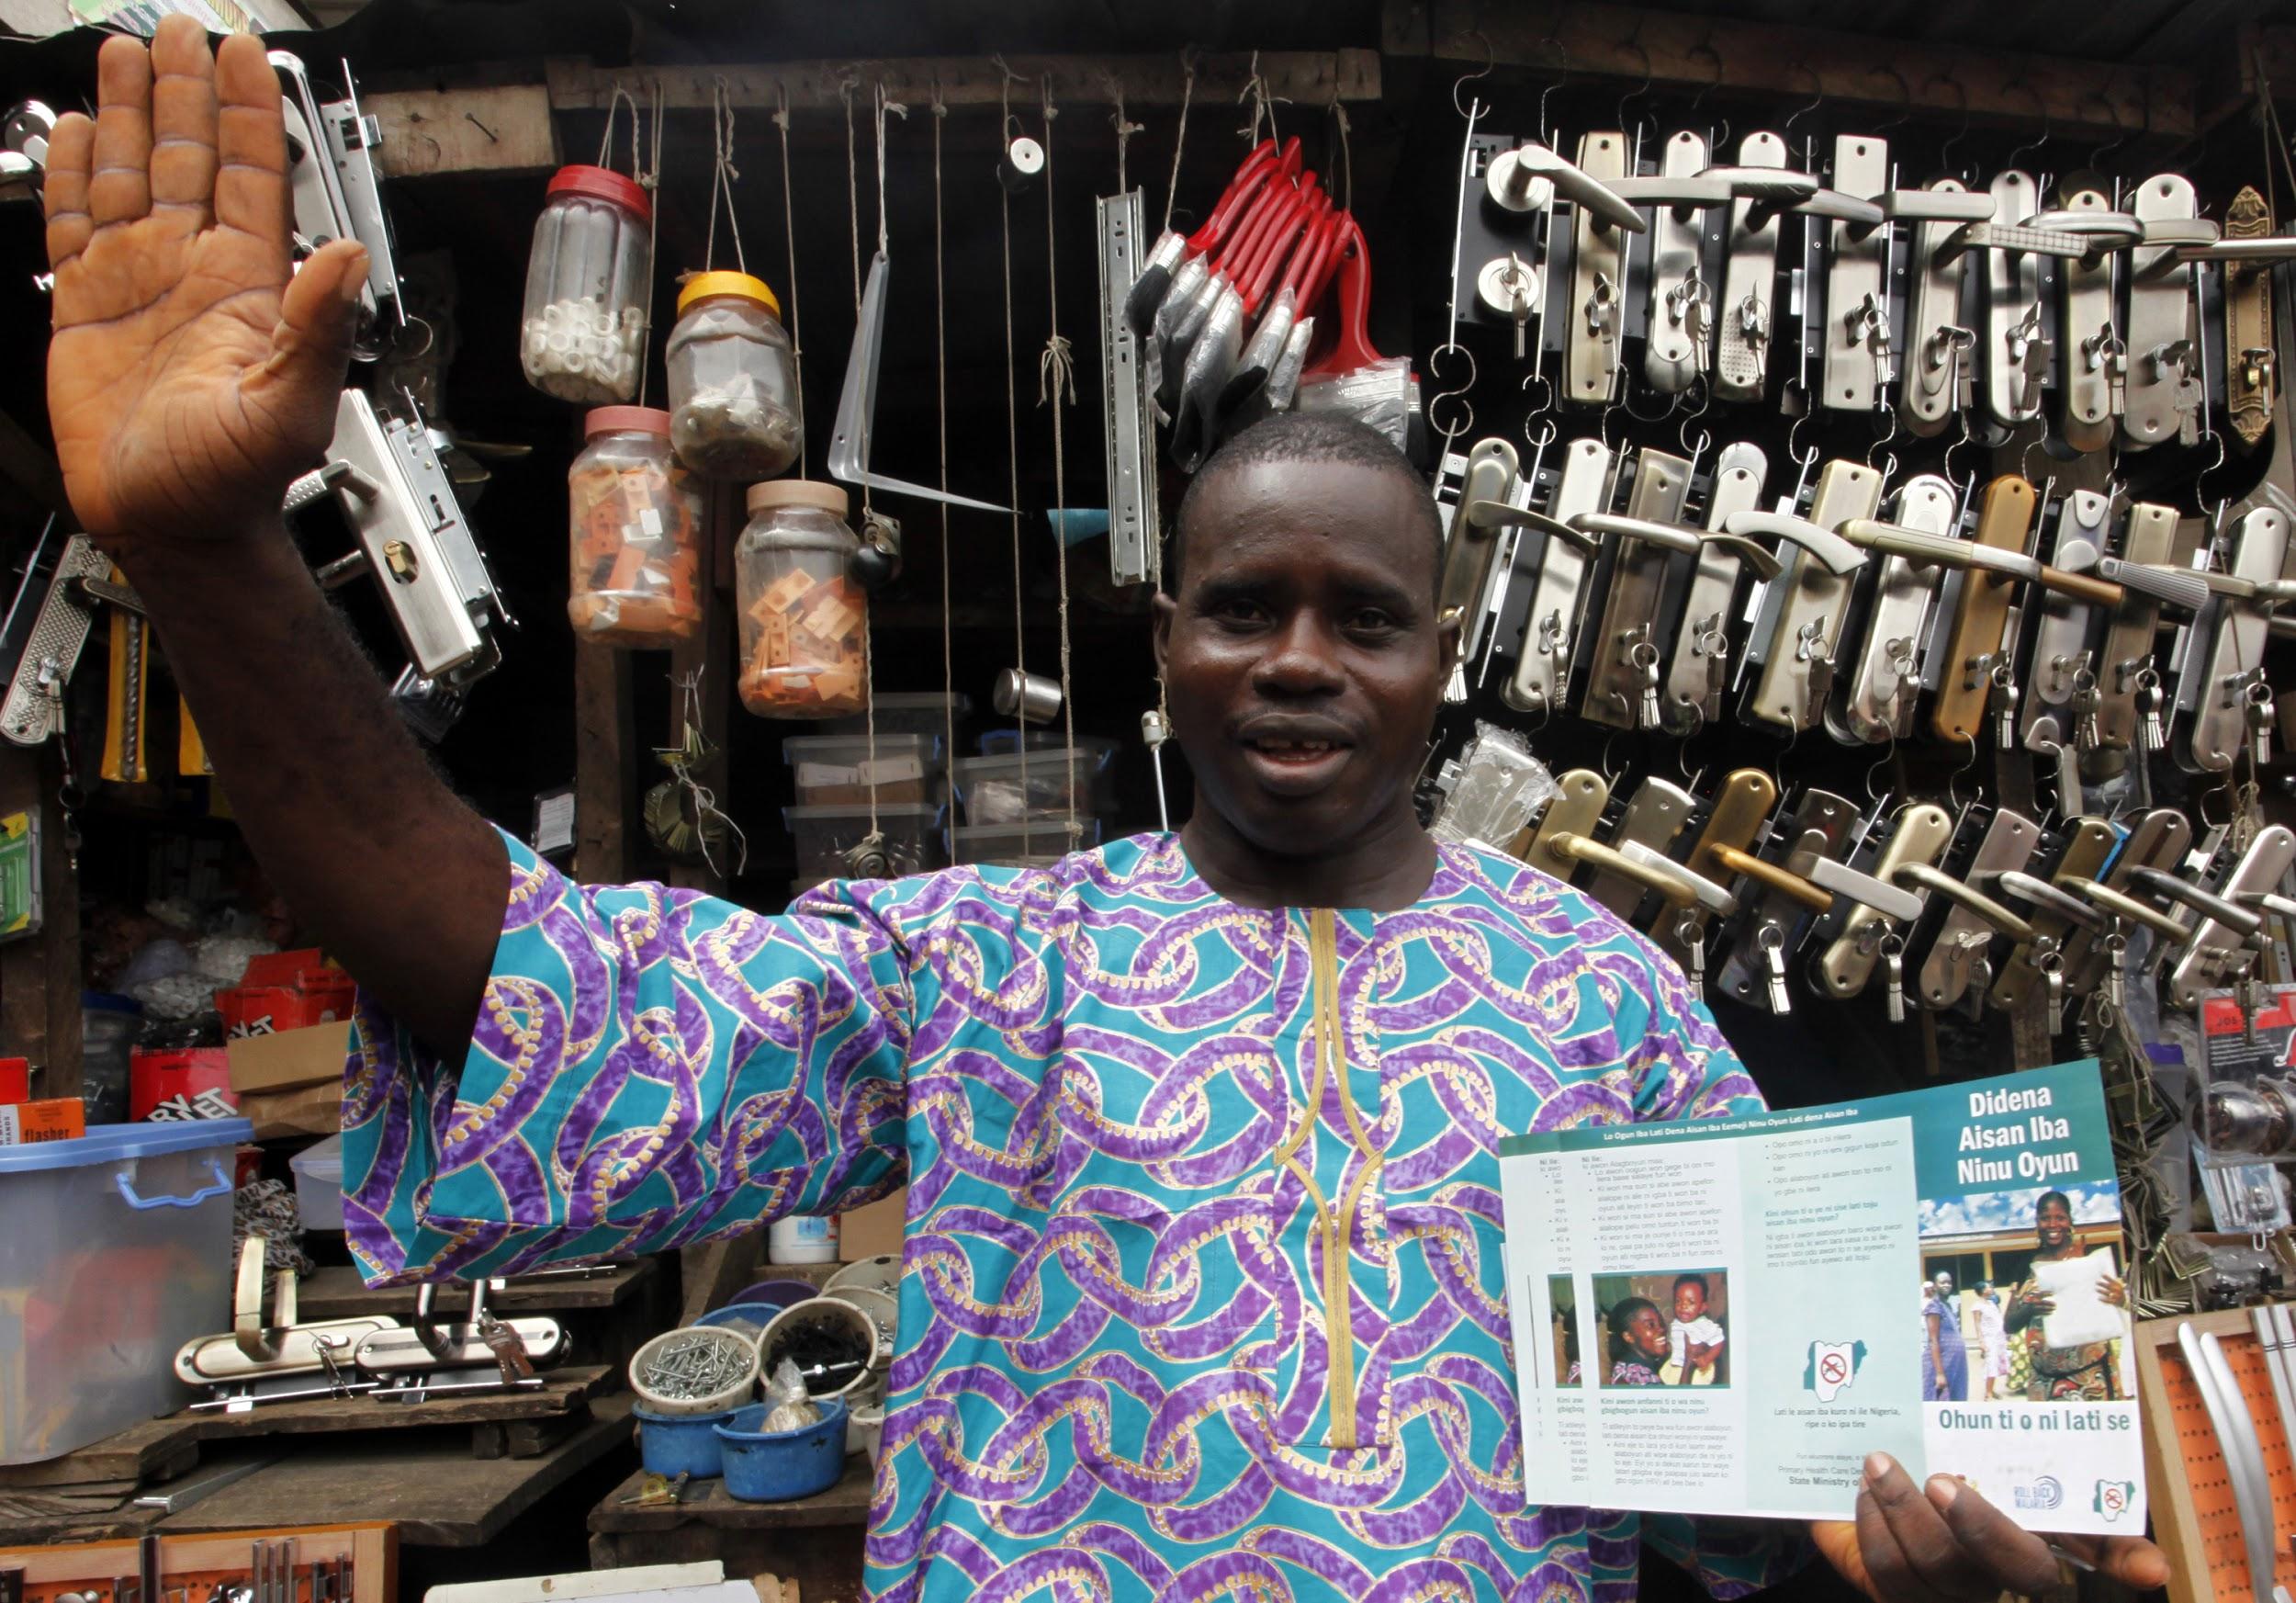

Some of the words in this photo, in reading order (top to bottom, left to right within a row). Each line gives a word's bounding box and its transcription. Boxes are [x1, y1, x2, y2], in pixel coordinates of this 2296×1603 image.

[1969, 1087, 2052, 1118] Didena
[1604, 1133, 1614, 1141] Lo
[1615, 1131, 1635, 1142] Ogun
[1636, 1129, 1649, 1138] Iba
[1649, 1127, 1663, 1137] Lati
[1664, 1127, 1685, 1136] Dena
[1686, 1124, 1707, 1135] Aisan
[1708, 1123, 1720, 1133] Iba
[1722, 1121, 1747, 1133] Eemeji
[1749, 1120, 1766, 1128] Ninu
[1768, 1117, 1788, 1128] Oyun
[1789, 1115, 1803, 1124] Lati
[1805, 1113, 1823, 1123] dena
[1824, 1111, 1845, 1121] Aisan
[1846, 1108, 1859, 1118] Iba
[1958, 1123, 2025, 1152] Aisan
[2030, 1115, 2070, 1143] Iba
[1957, 1157, 2012, 1184] Ninu
[2018, 1150, 2079, 1182] Oyun
[1939, 1408, 1992, 1429] Ohun
[1998, 1409, 2012, 1430] ti
[2020, 1414, 2032, 1430] o
[2039, 1409, 2058, 1430] ni
[2066, 1409, 2101, 1430] lati
[2107, 1414, 2130, 1431] se
[1789, 1476, 1810, 1485] State
[1813, 1477, 1850, 1487] Ministry
